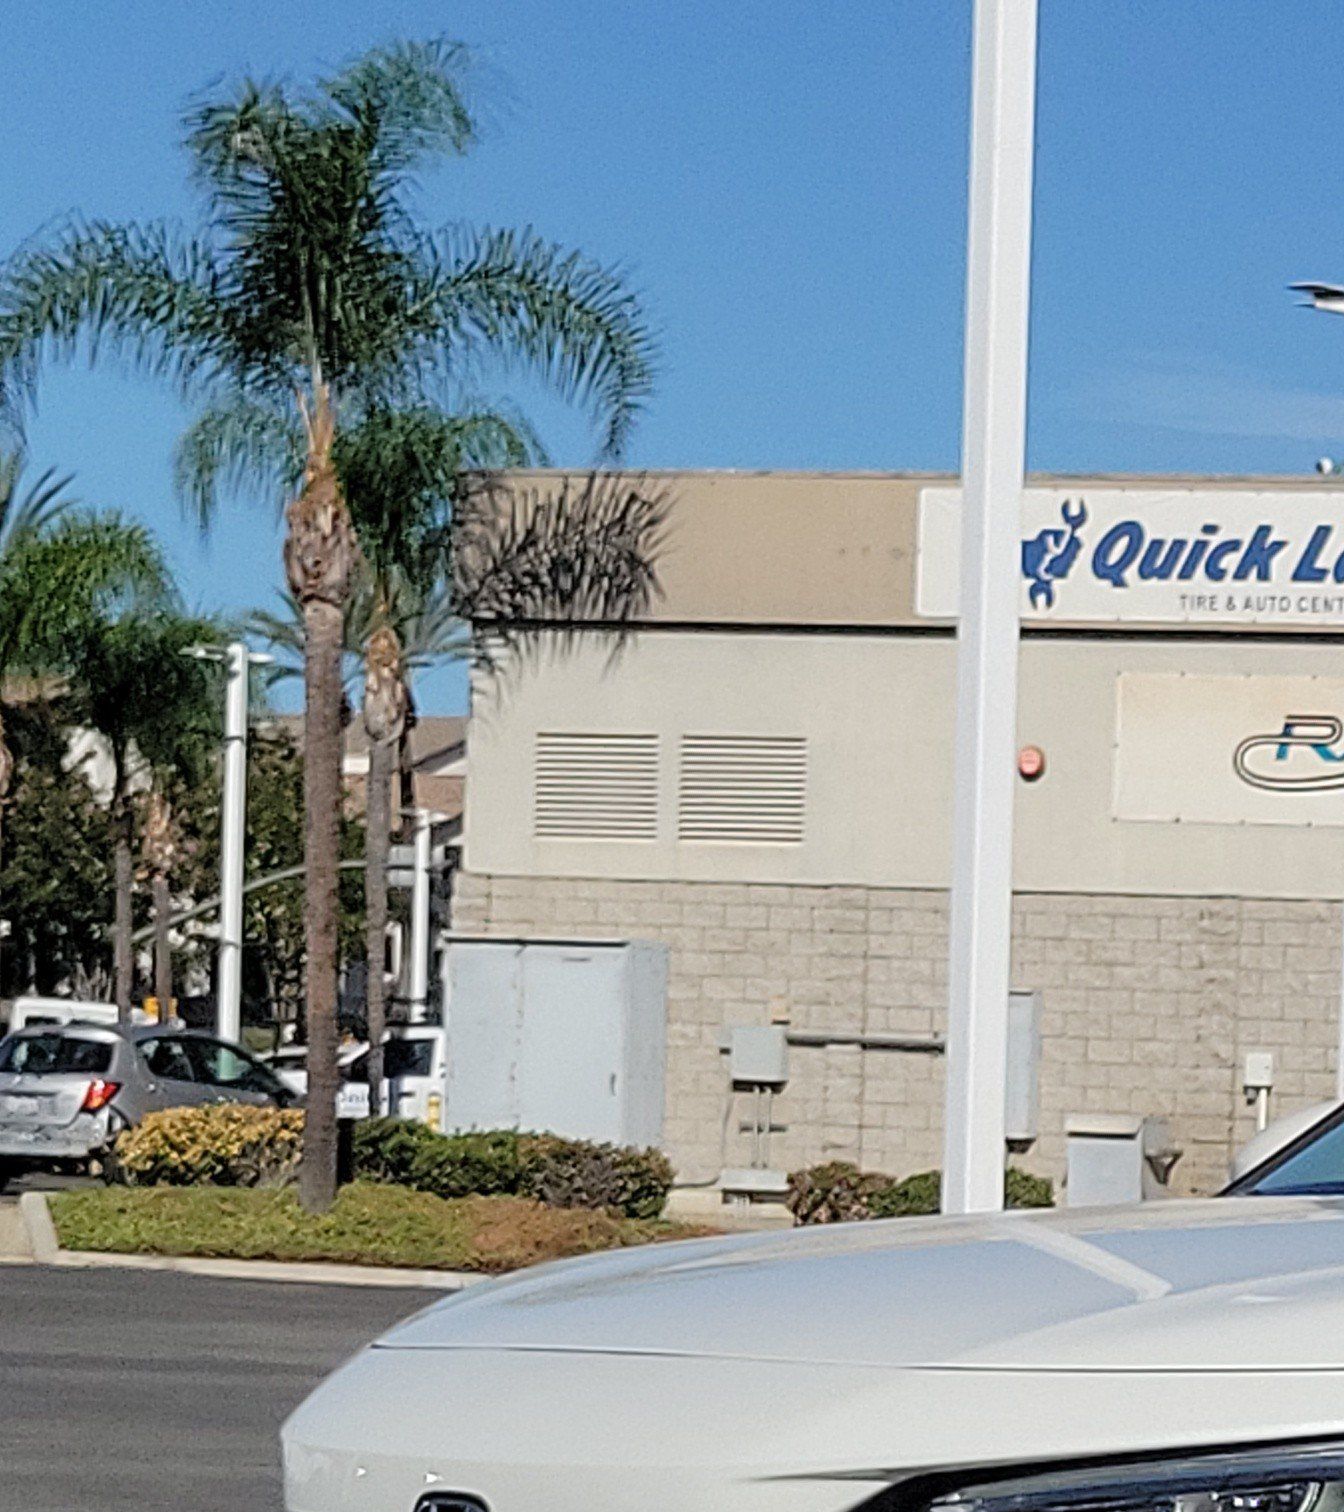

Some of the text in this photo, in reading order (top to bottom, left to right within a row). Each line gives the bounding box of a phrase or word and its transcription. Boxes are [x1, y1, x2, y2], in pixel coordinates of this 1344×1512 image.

[1092, 520, 1288, 588] Quick
[1179, 595, 1219, 612] TIRE
[1226, 596, 1237, 612] &
[1243, 595, 1290, 613] AUTO
